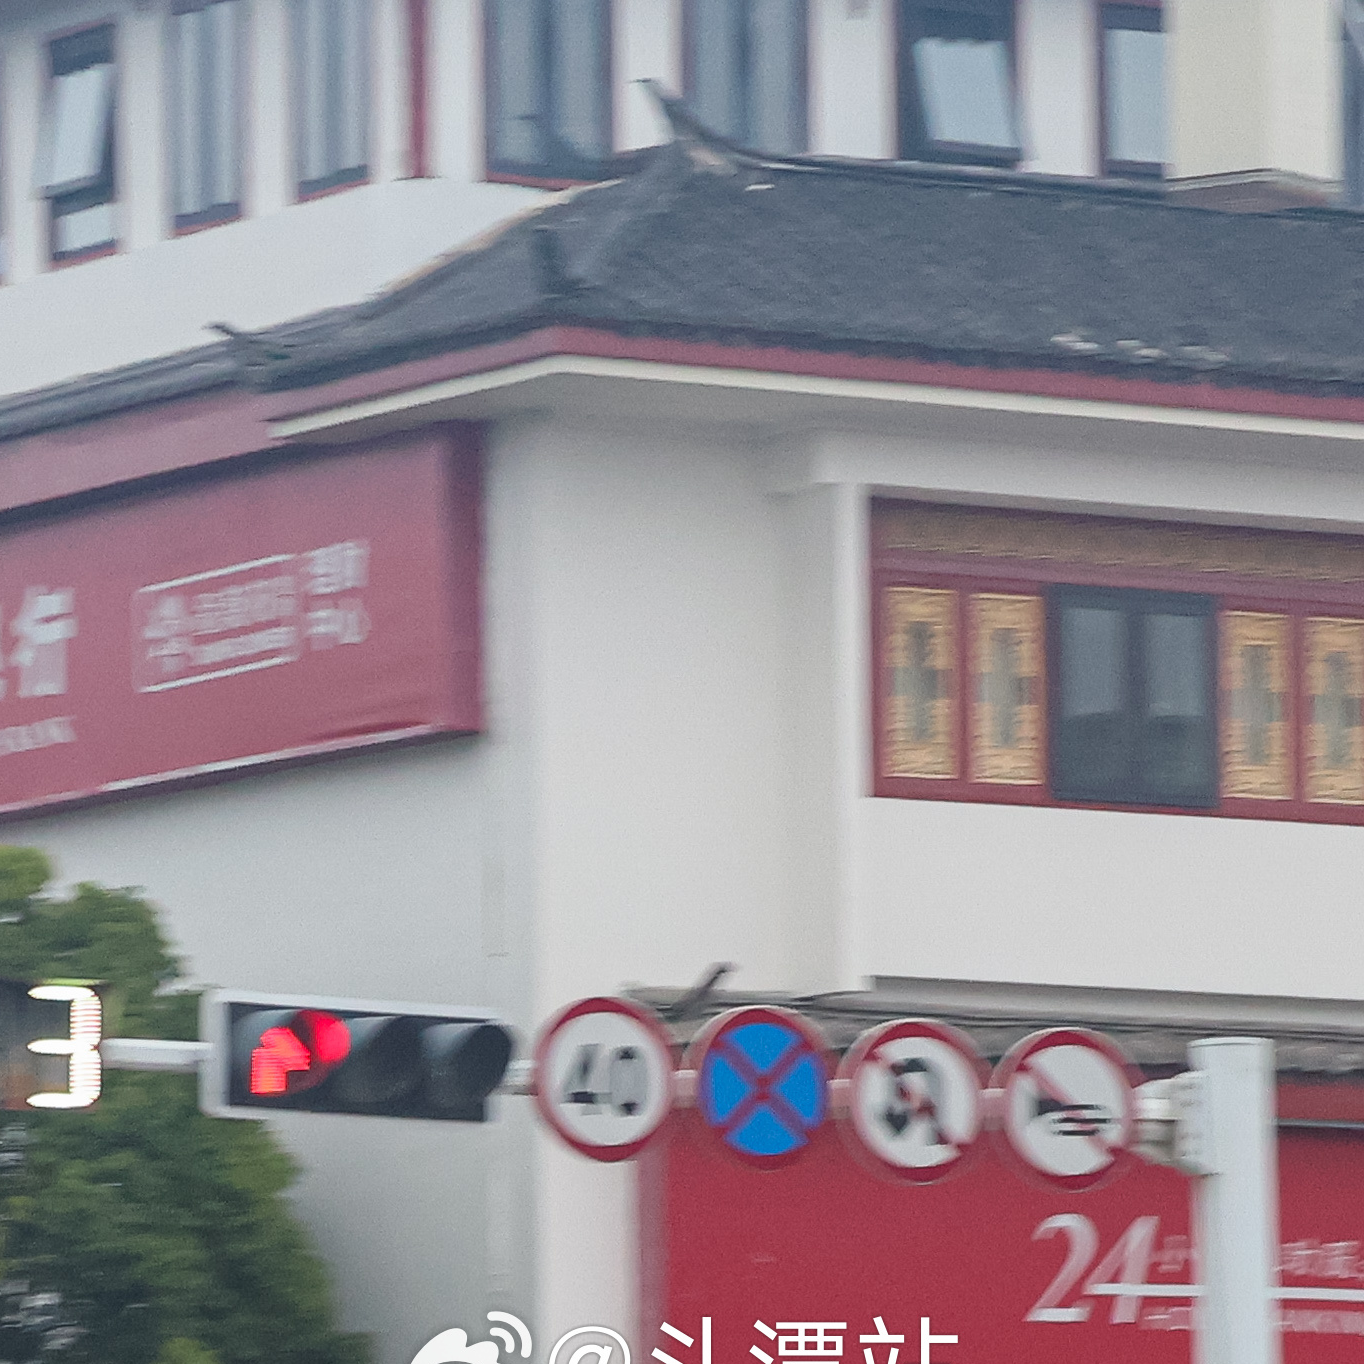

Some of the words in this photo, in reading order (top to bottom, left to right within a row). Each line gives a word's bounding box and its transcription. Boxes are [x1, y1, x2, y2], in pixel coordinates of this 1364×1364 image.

[26, 985, 102, 1108] 3
[560, 1043, 650, 1117] 40
[1023, 1212, 1161, 1325] 24
